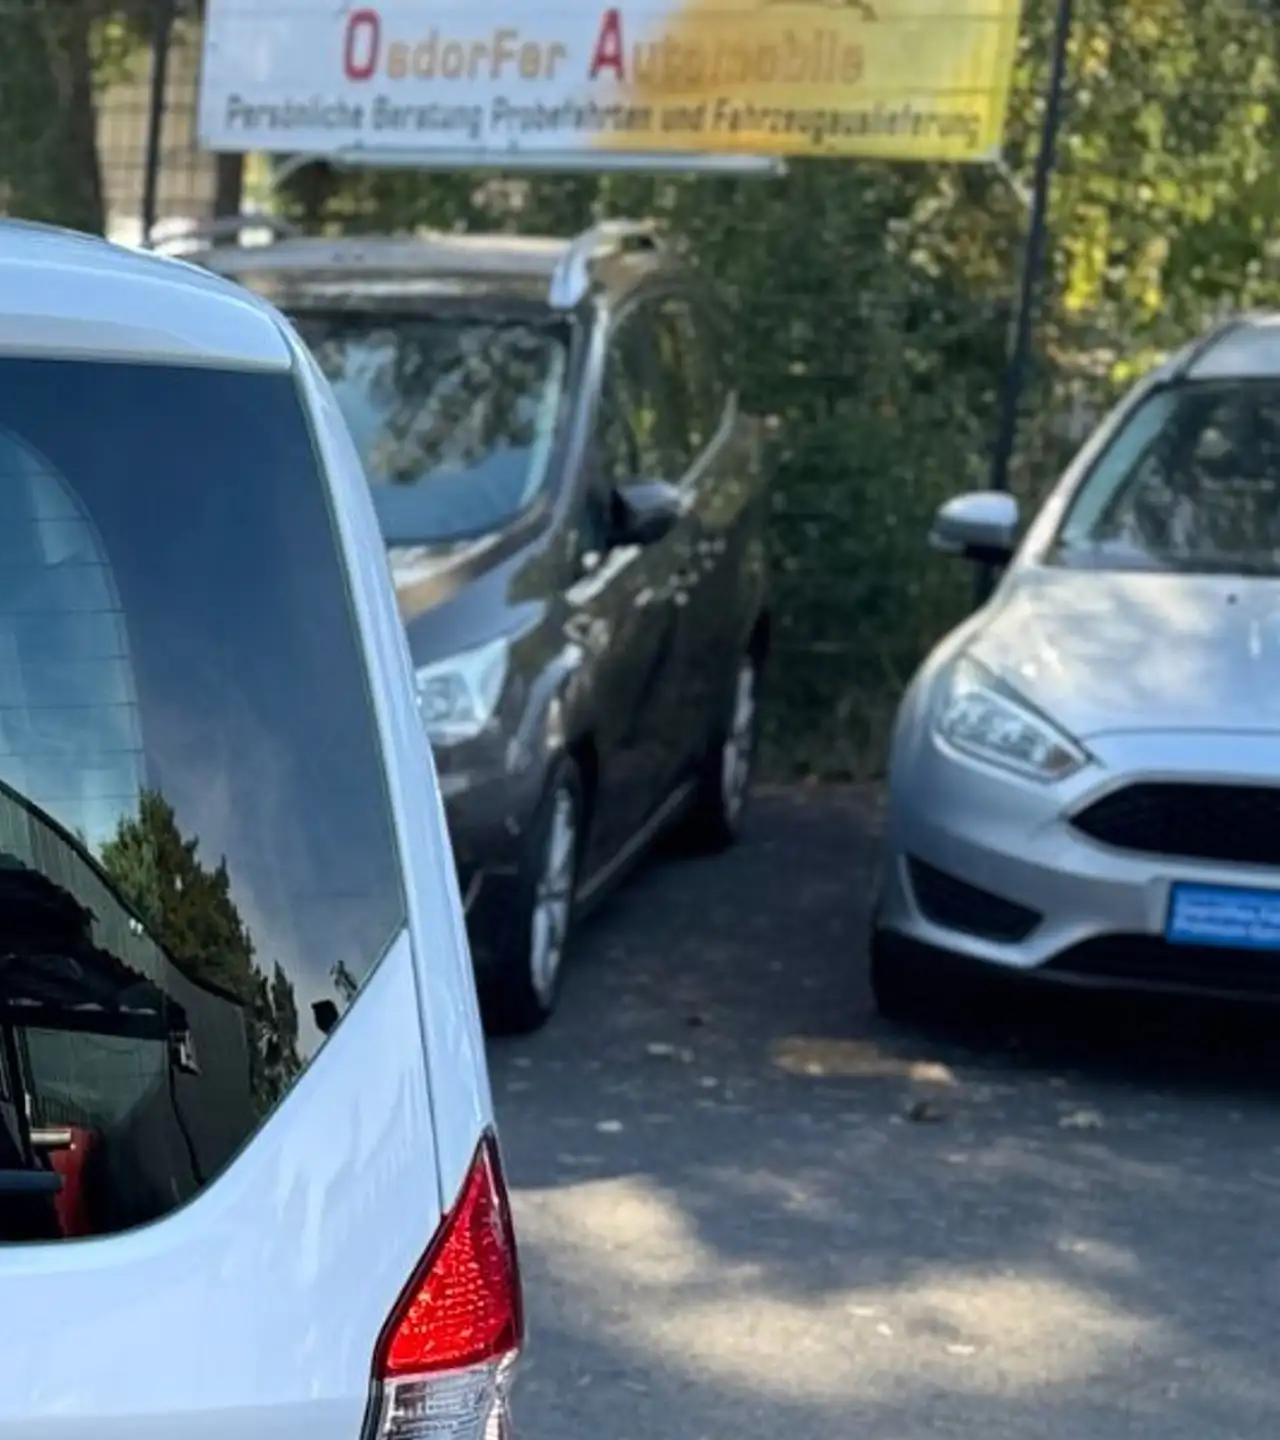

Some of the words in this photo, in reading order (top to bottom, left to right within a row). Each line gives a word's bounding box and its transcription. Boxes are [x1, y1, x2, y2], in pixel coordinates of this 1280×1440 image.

[589, 8, 865, 84] Automobile
[226, 93, 365, 131] Persönliche
[371, 93, 483, 139] Beratung
[492, 96, 653, 133] Probefahrten
[662, 103, 704, 132] und
[713, 98, 981, 148] Fahrzeugauslieferung
